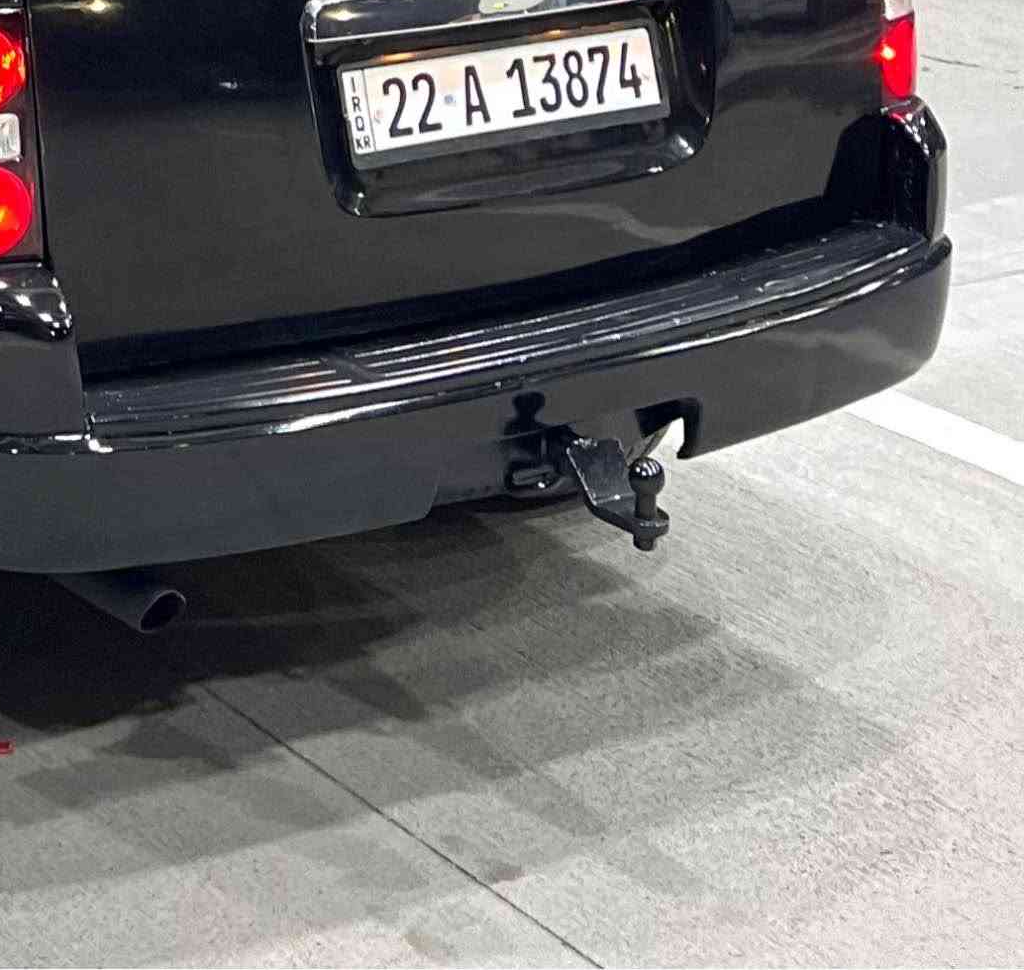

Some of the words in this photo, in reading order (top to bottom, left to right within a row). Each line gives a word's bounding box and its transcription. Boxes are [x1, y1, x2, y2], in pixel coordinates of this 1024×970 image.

[382, 73, 443, 138] 22
[464, 65, 491, 126] A
[506, 42, 643, 118] 13874
